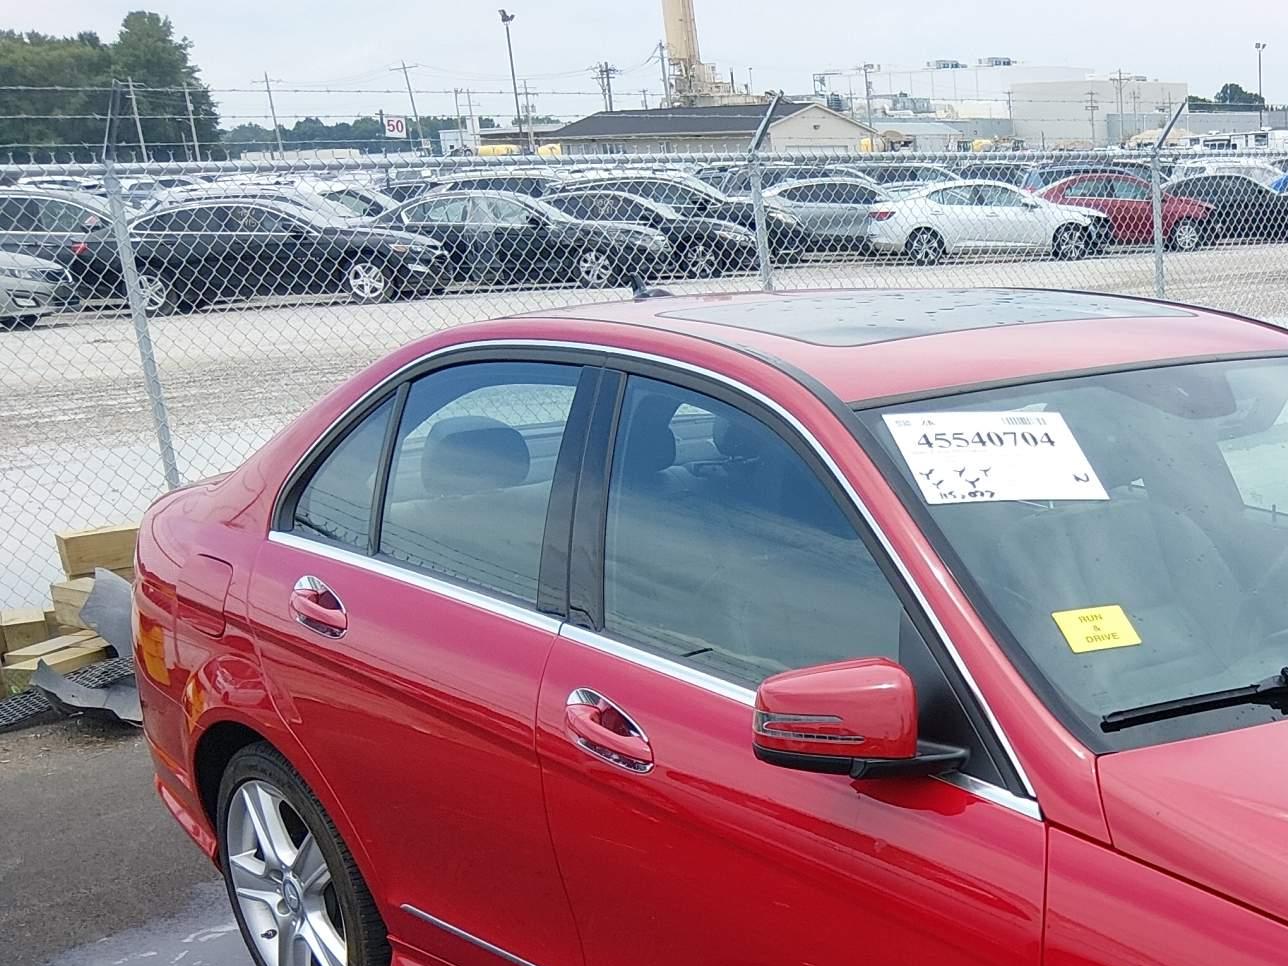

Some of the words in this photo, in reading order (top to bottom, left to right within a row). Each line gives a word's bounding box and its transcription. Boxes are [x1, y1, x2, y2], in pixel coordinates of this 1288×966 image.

[386, 119, 404, 133] 50
[917, 431, 1056, 449] 45540704
[1078, 613, 1103, 624] RUN
[1092, 624, 1101, 632] &
[1085, 632, 1121, 644] DRIVE
